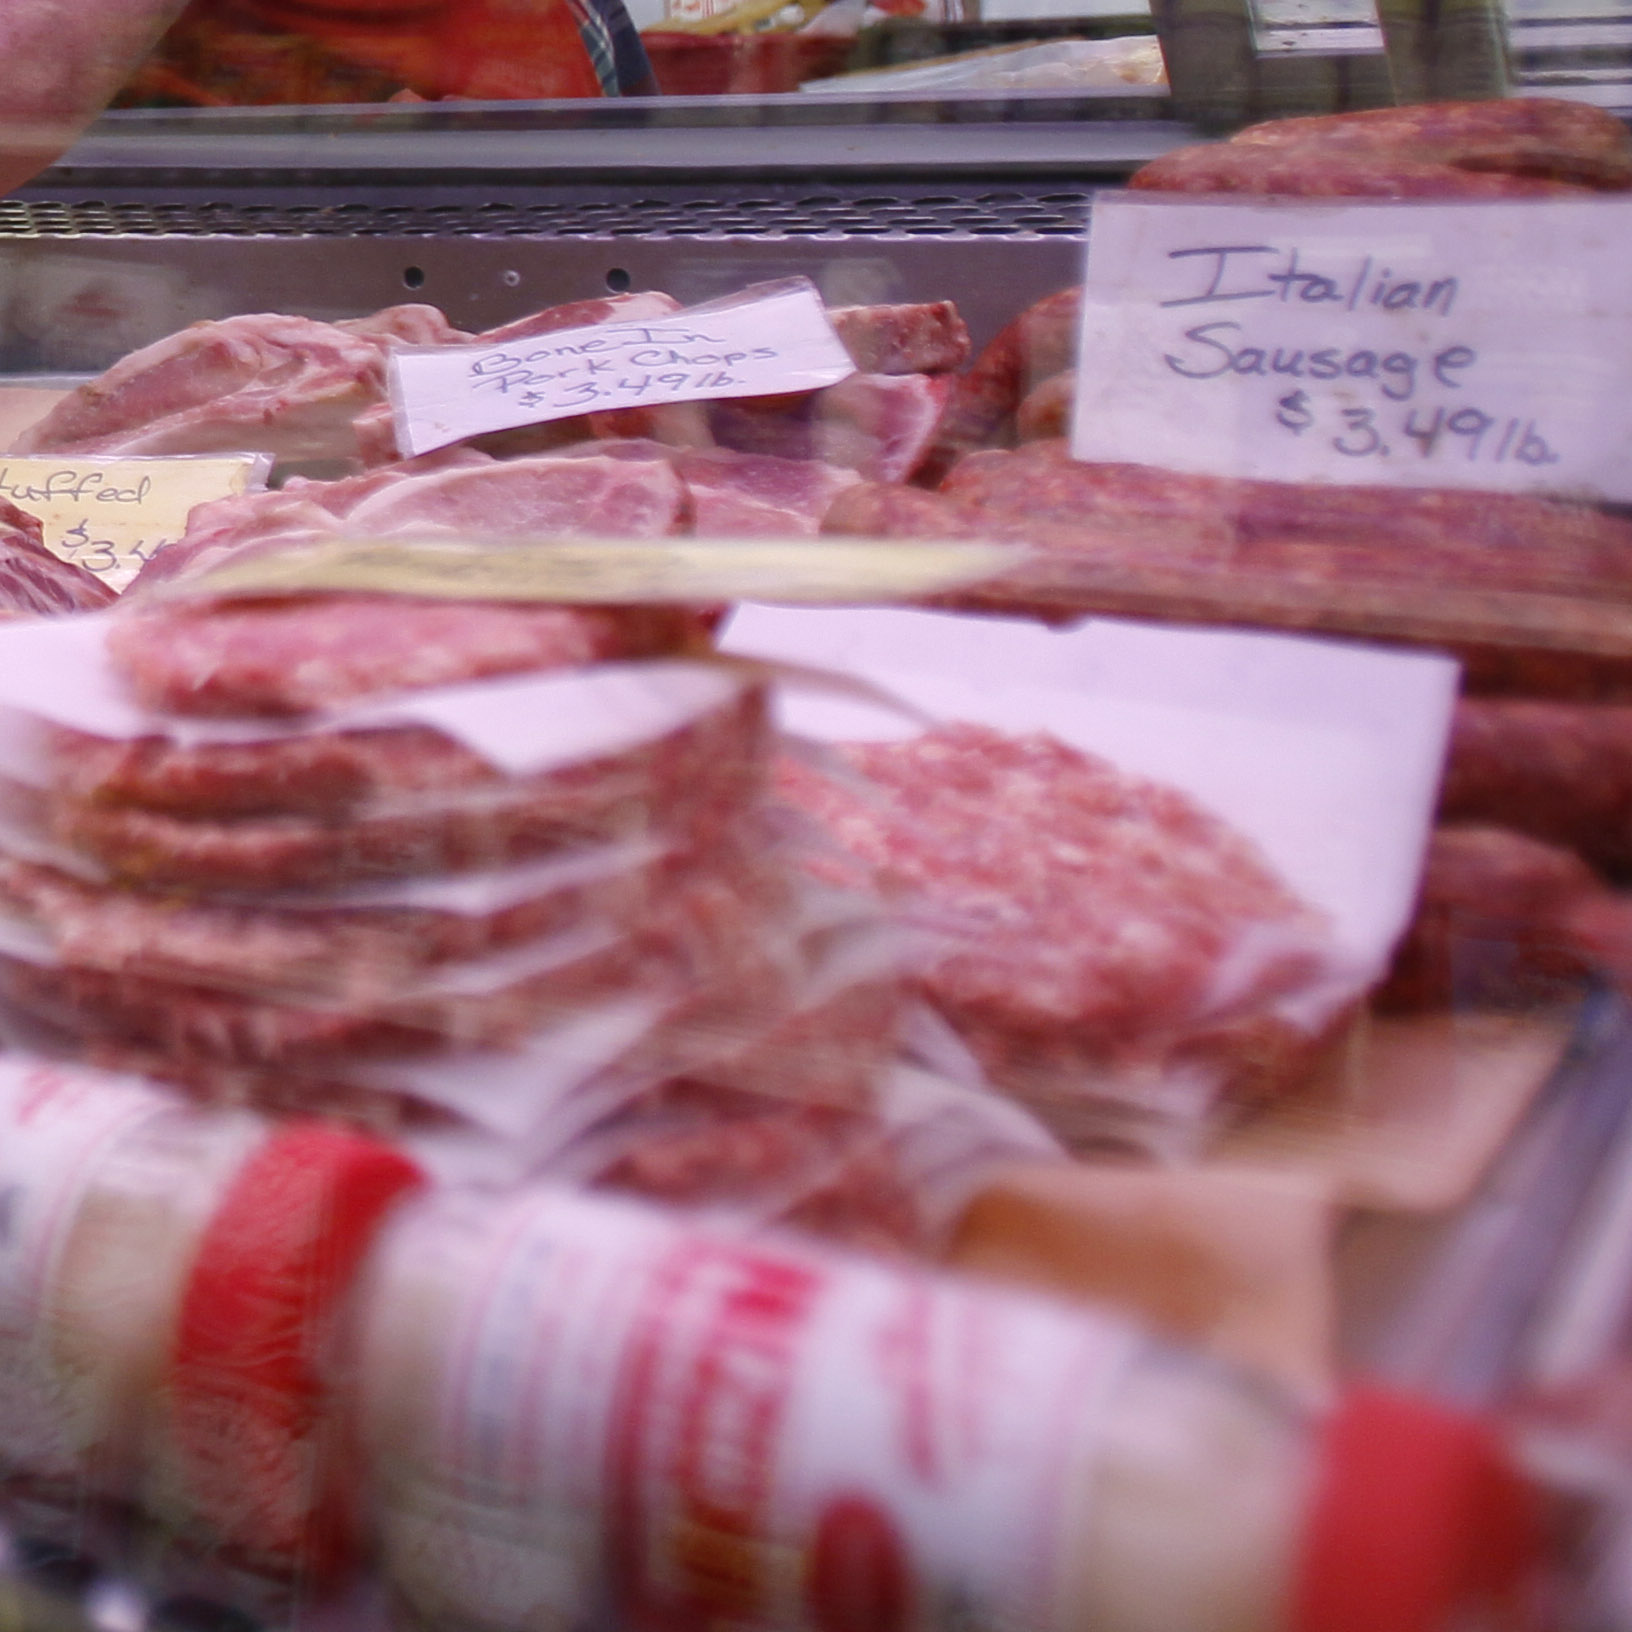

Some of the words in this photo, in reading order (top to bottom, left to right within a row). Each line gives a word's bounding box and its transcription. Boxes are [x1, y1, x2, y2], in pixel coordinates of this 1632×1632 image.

[1160, 245, 1458, 317] Italian
[469, 336, 609, 377] Bone
[609, 327, 725, 348] In
[472, 358, 616, 395] Pork
[630, 344, 778, 369] Chops
[1165, 321, 1476, 401] Sausage
